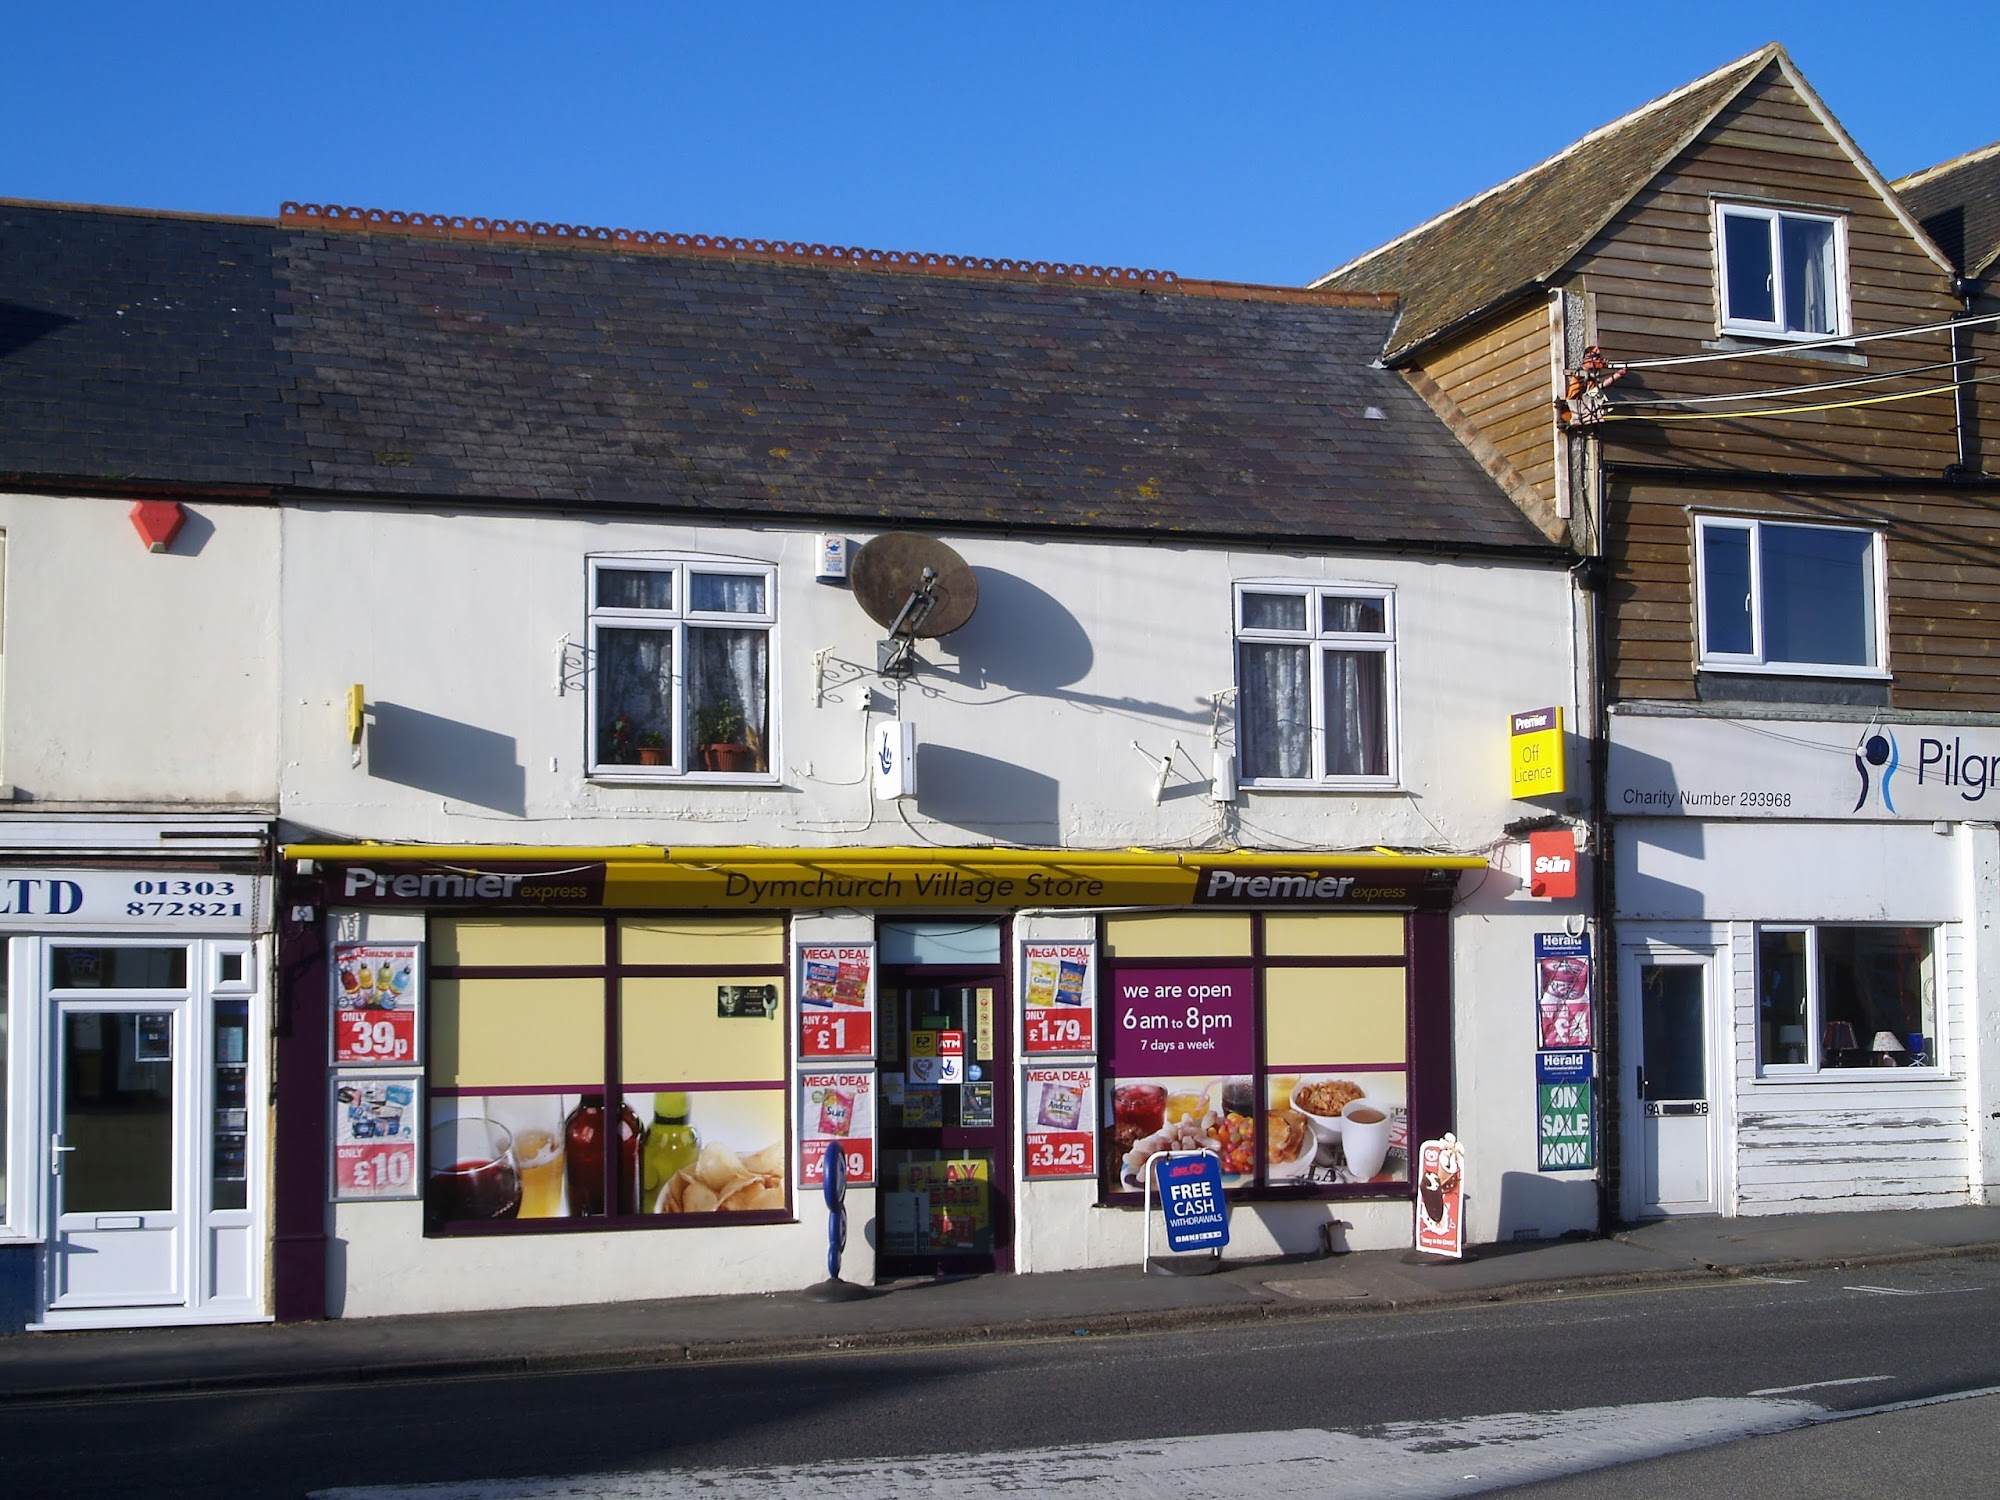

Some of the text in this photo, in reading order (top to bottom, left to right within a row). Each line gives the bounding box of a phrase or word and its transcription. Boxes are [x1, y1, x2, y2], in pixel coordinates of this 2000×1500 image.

[1516, 714, 1547, 730] Premier
[1522, 744, 1539, 763] Off
[1514, 766, 1552, 783] Licence
[1624, 788, 1791, 808] Charity Number 293968
[1535, 855, 1571, 873] Sun
[133, 881, 236, 896] 01303
[345, 867, 588, 903] Premier express
[725, 870, 1103, 904] Dymchurch Village Store
[1207, 870, 1406, 902] Premier express
[126, 901, 244, 917] 872821
[802, 949, 869, 959] MEGA DEAL
[1026, 948, 1090, 958] MEGA DEAL
[1123, 984, 1231, 1003] we are open
[341, 1012, 366, 1022] ONLY
[803, 1015, 829, 1025] ANY 2
[1025, 1011, 1046, 1021] ONLY
[1123, 1007, 1232, 1034] 6am to 8pm
[817, 1018, 845, 1049] £1
[1029, 1019, 1081, 1042] £1.79
[351, 1021, 408, 1058] 39p
[939, 1040, 961, 1049] ATM
[1141, 1038, 1215, 1053] 7 days a week
[1544, 1054, 1583, 1066] Herald
[803, 1075, 869, 1087] MEGA DEAL
[1027, 1071, 1091, 1082] MEGA DEAL
[1551, 1086, 1577, 1109] ON
[827, 1106, 846, 1118] Surf
[1048, 1101, 1072, 1112] Andrex
[1542, 1113, 1589, 1137] SALE
[1027, 1135, 1047, 1144] ONLY
[339, 1149, 362, 1158] ONLY
[1032, 1143, 1085, 1166] £3.25
[1542, 1142, 1587, 1166] NOW
[354, 1151, 410, 1187] £10
[1171, 1182, 1213, 1200] FREE
[1174, 1199, 1215, 1217] CASH
[1169, 1213, 1223, 1227] WITHDRAWALS
